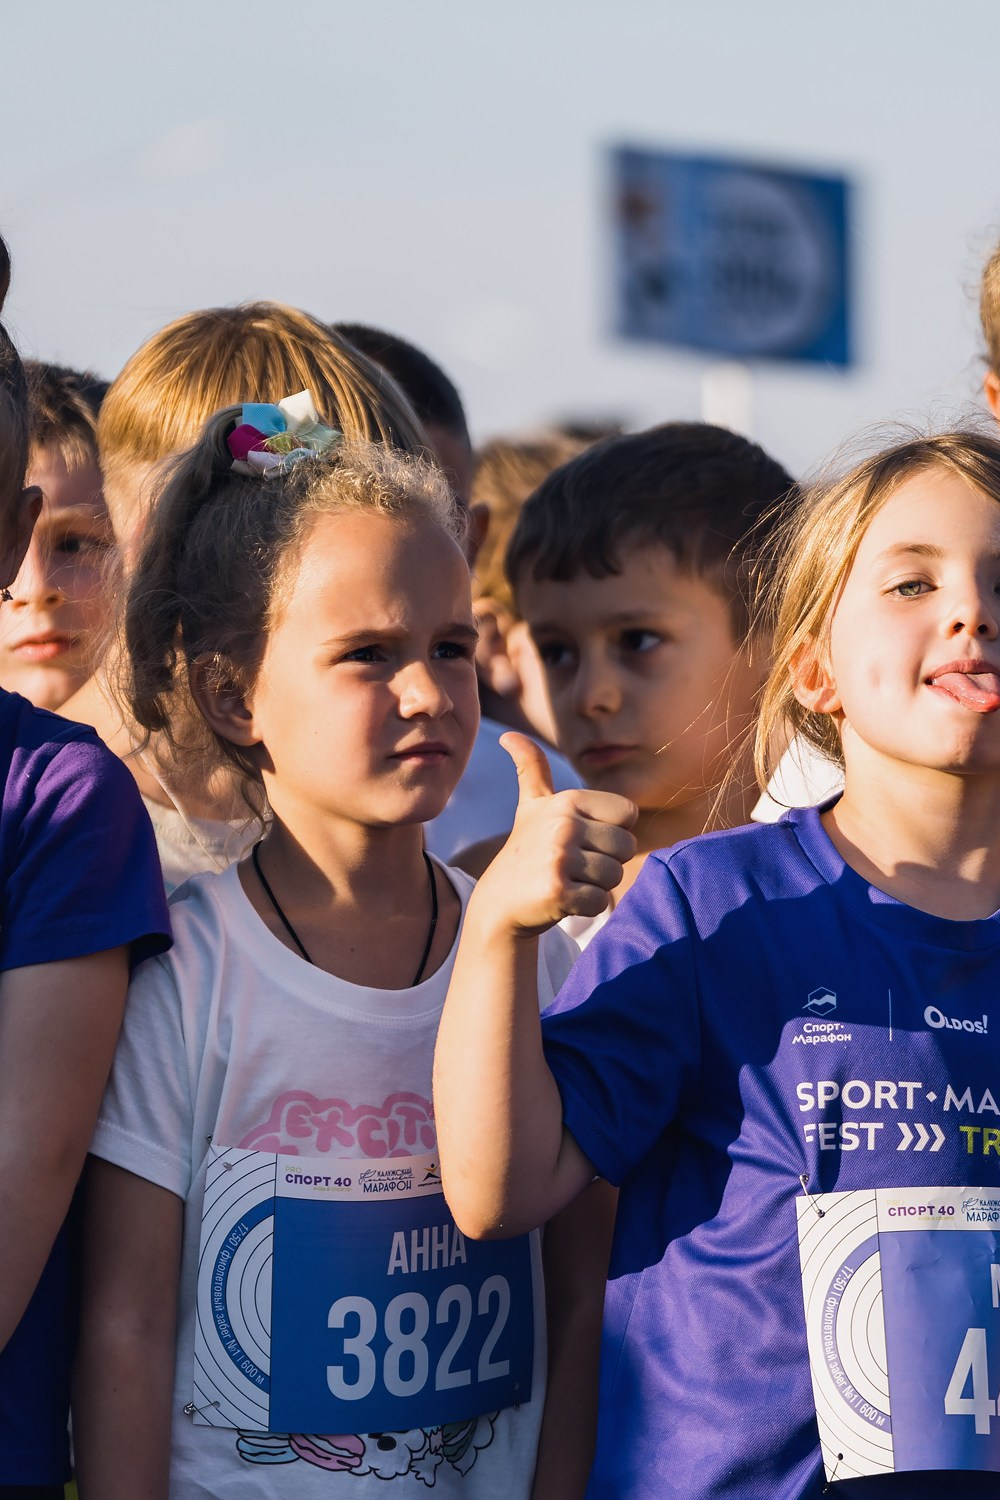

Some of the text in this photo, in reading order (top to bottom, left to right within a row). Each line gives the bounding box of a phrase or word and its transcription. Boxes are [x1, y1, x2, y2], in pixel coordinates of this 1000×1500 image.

[792, 1033, 851, 1045] Марафон
[796, 1079, 922, 1112] SPORT
[803, 1122, 884, 1151] FEST
[285, 1166, 302, 1174] PRO
[285, 1173, 352, 1187] СПОРТ 40
[377, 1167, 412, 1178] КАЛУЖСКИЙ
[363, 1180, 412, 1193] МАРАФОН
[888, 1205, 955, 1217] СПОРТ 40
[387, 1224, 467, 1275] АННА
[213, 1222, 265, 1385] 17:50 фиолетовый забег №1 600 м
[326, 1275, 511, 1401] 3822
[823, 1265, 885, 1427] 17:50 фиолетовый забег №1 600 м
